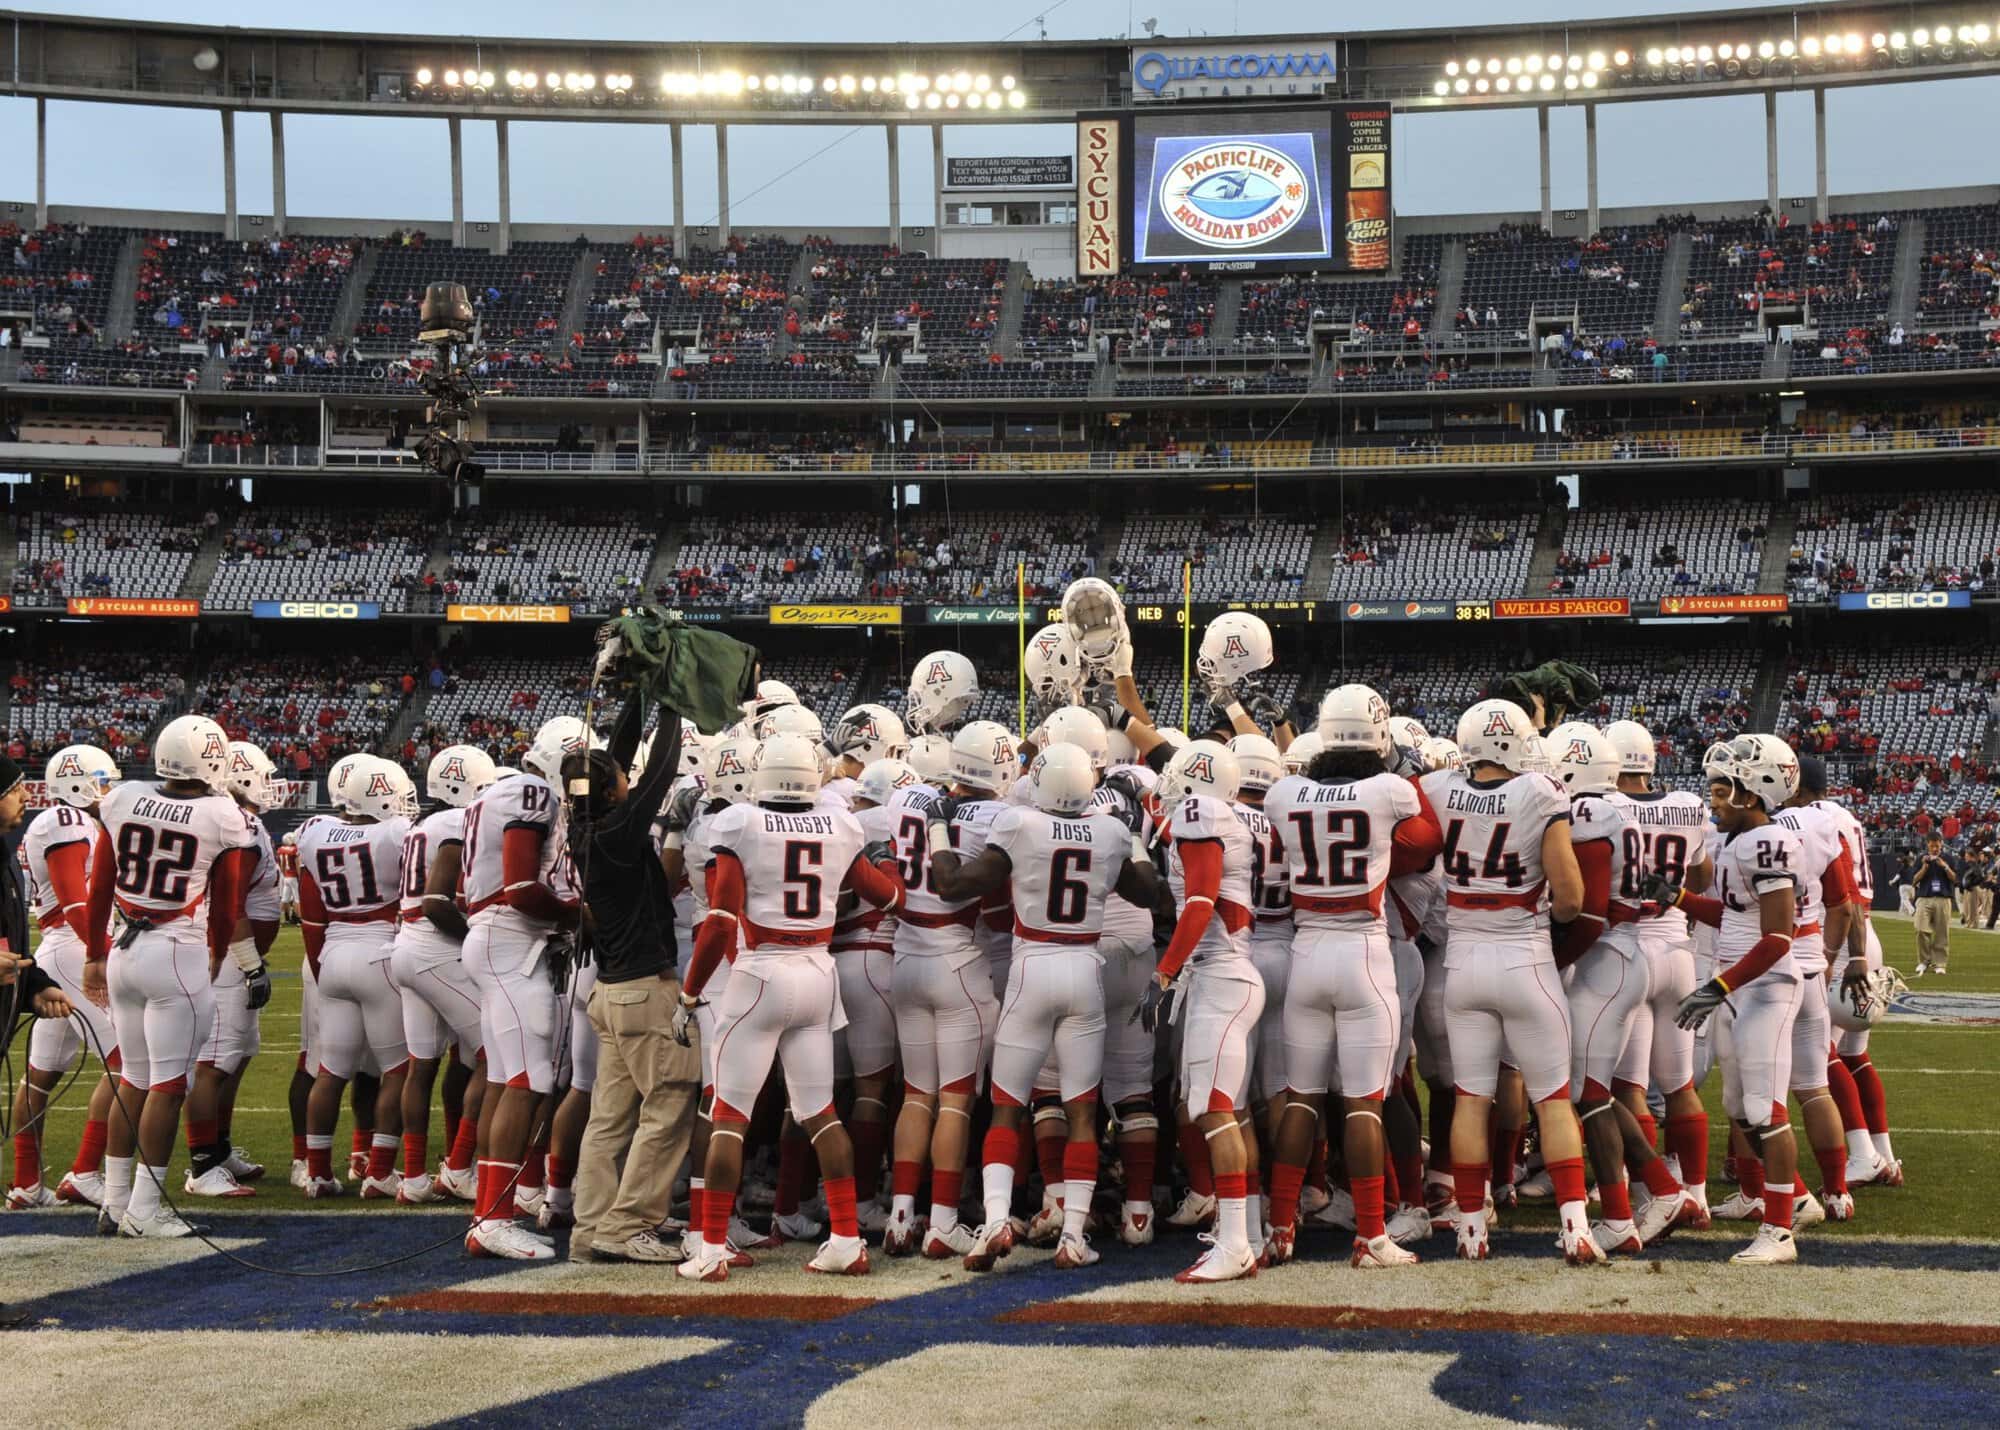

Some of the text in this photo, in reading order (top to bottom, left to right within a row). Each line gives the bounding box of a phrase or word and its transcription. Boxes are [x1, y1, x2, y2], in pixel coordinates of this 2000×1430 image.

[1134, 52, 1336, 98] QUALCOMM
[1182, 150, 1285, 180] PACIFIC LIFE
[953, 175, 990, 184] LOCATION
[992, 175, 1008, 183] AND
[1087, 127, 1110, 270] SYCUAN
[1174, 204, 1294, 239] HOLIDAY BOWL
[1352, 219, 1385, 231] BUD
[1347, 228, 1389, 240] LIGHT
[98, 602, 195, 612] SYCUAN RESORT
[280, 602, 359, 618] GEICO
[1364, 606, 1388, 617] pepsi
[1501, 601, 1560, 615] WELLS
[1564, 600, 1622, 614] FARGO
[1690, 598, 1783, 609] SYCUAN RESORT
[1867, 592, 1949, 608] GEICO
[461, 606, 555, 621] CYMER
[944, 609, 979, 622] Degree
[522, 784, 551, 811] 87
[1314, 785, 1357, 803] HALL
[1446, 789, 1506, 815] ELMORE
[57, 807, 86, 827] 81
[132, 796, 194, 825] CRINER
[1183, 797, 1200, 823] 2
[764, 814, 833, 835] GRIGSBY
[1052, 821, 1092, 842] ROSS
[1288, 809, 1371, 886] 12
[1443, 818, 1527, 889] 44
[1756, 840, 1789, 868] 24
[116, 822, 199, 903] 82
[316, 842, 384, 909] 51
[783, 840, 823, 919] 5
[1045, 847, 1093, 924] 6
